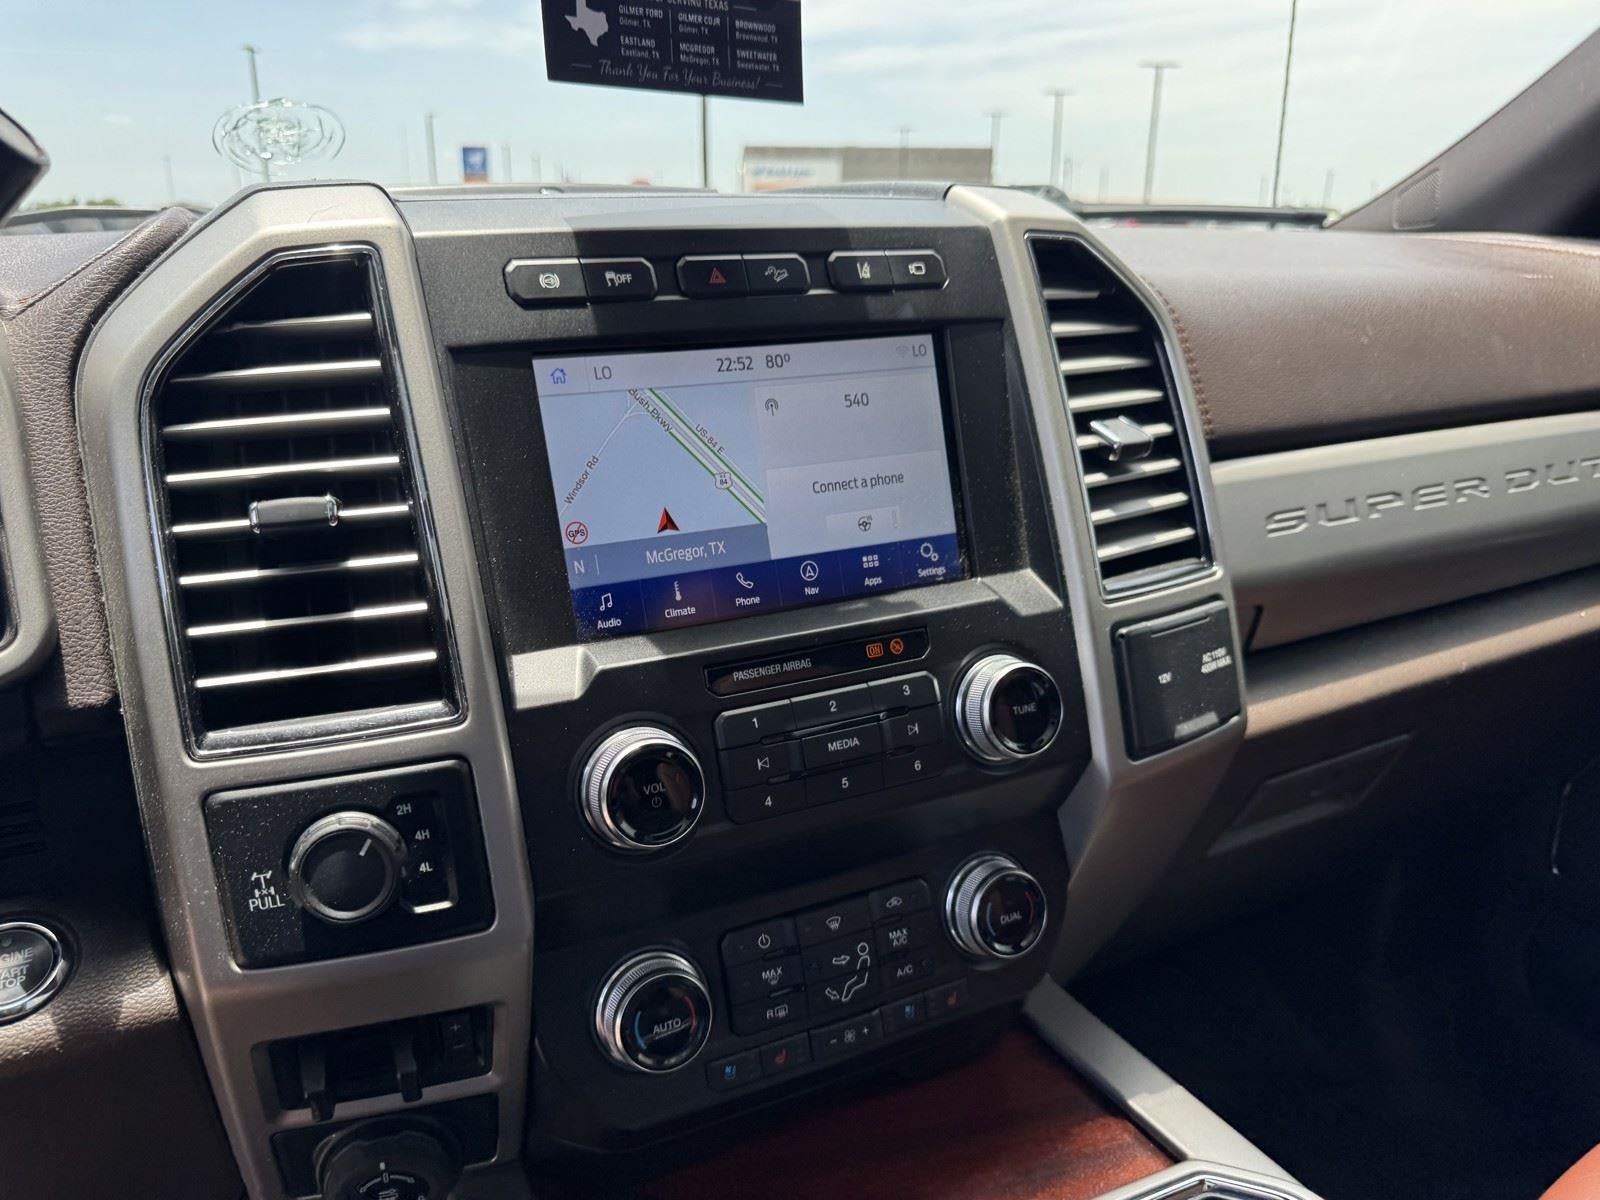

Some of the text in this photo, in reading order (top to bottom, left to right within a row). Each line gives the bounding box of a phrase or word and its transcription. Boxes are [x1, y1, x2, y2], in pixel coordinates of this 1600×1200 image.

[619, 4, 663, 19] GILMER FORD
[705, 0, 728, 11] TEXAS
[643, 19, 651, 28] TX
[678, 12, 702, 24] GILMER
[701, 26, 709, 35] TX
[735, 20, 776, 33] BROWNWOOD
[620, 35, 656, 48] EASTLAND
[680, 42, 715, 54] MCGREGOR
[652, 50, 660, 59] TX
[736, 49, 778, 62] SWEETWATER
[599, 58, 761, 89] Thank You For Your Business!
[616, 273, 632, 284] OFF
[593, 366, 612, 380] LO
[716, 356, 754, 372] 22:52
[912, 344, 927, 358] LO
[844, 392, 870, 408] 540
[650, 408, 673, 433] Pkwy
[717, 446, 726, 456] E
[564, 454, 600, 505] Windsor Rd
[812, 472, 904, 494] Connect a phone
[1266, 477, 1491, 537] SUPER
[574, 540, 727, 574] N McGregor, TX
[917, 564, 947, 578] Settings
[864, 576, 883, 588] Apps
[804, 585, 820, 596] Nav
[735, 594, 761, 606] Phone
[664, 605, 696, 618] Climate
[597, 616, 622, 630] Audio
[732, 658, 812, 682] PASSENGER AIRBAG
[903, 684, 910, 696] 3
[829, 700, 837, 712] 2
[1013, 703, 1038, 715] TUNE
[752, 718, 759, 728] 1
[828, 736, 860, 752] MEDIA
[914, 760, 922, 771] 6
[643, 782, 666, 795] VOL
[842, 778, 849, 789] 5
[764, 796, 772, 808] 4
[396, 802, 412, 816] 2H
[414, 828, 430, 841] 4H
[419, 862, 433, 873] 4L
[248, 896, 285, 912] PULL
[1000, 910, 1022, 925] DUAL
[889, 928, 909, 940] MAX
[893, 936, 908, 948] A/C
[762, 966, 783, 981] MAX
[896, 964, 913, 978] A/C
[653, 1018, 682, 1034] AUTO
